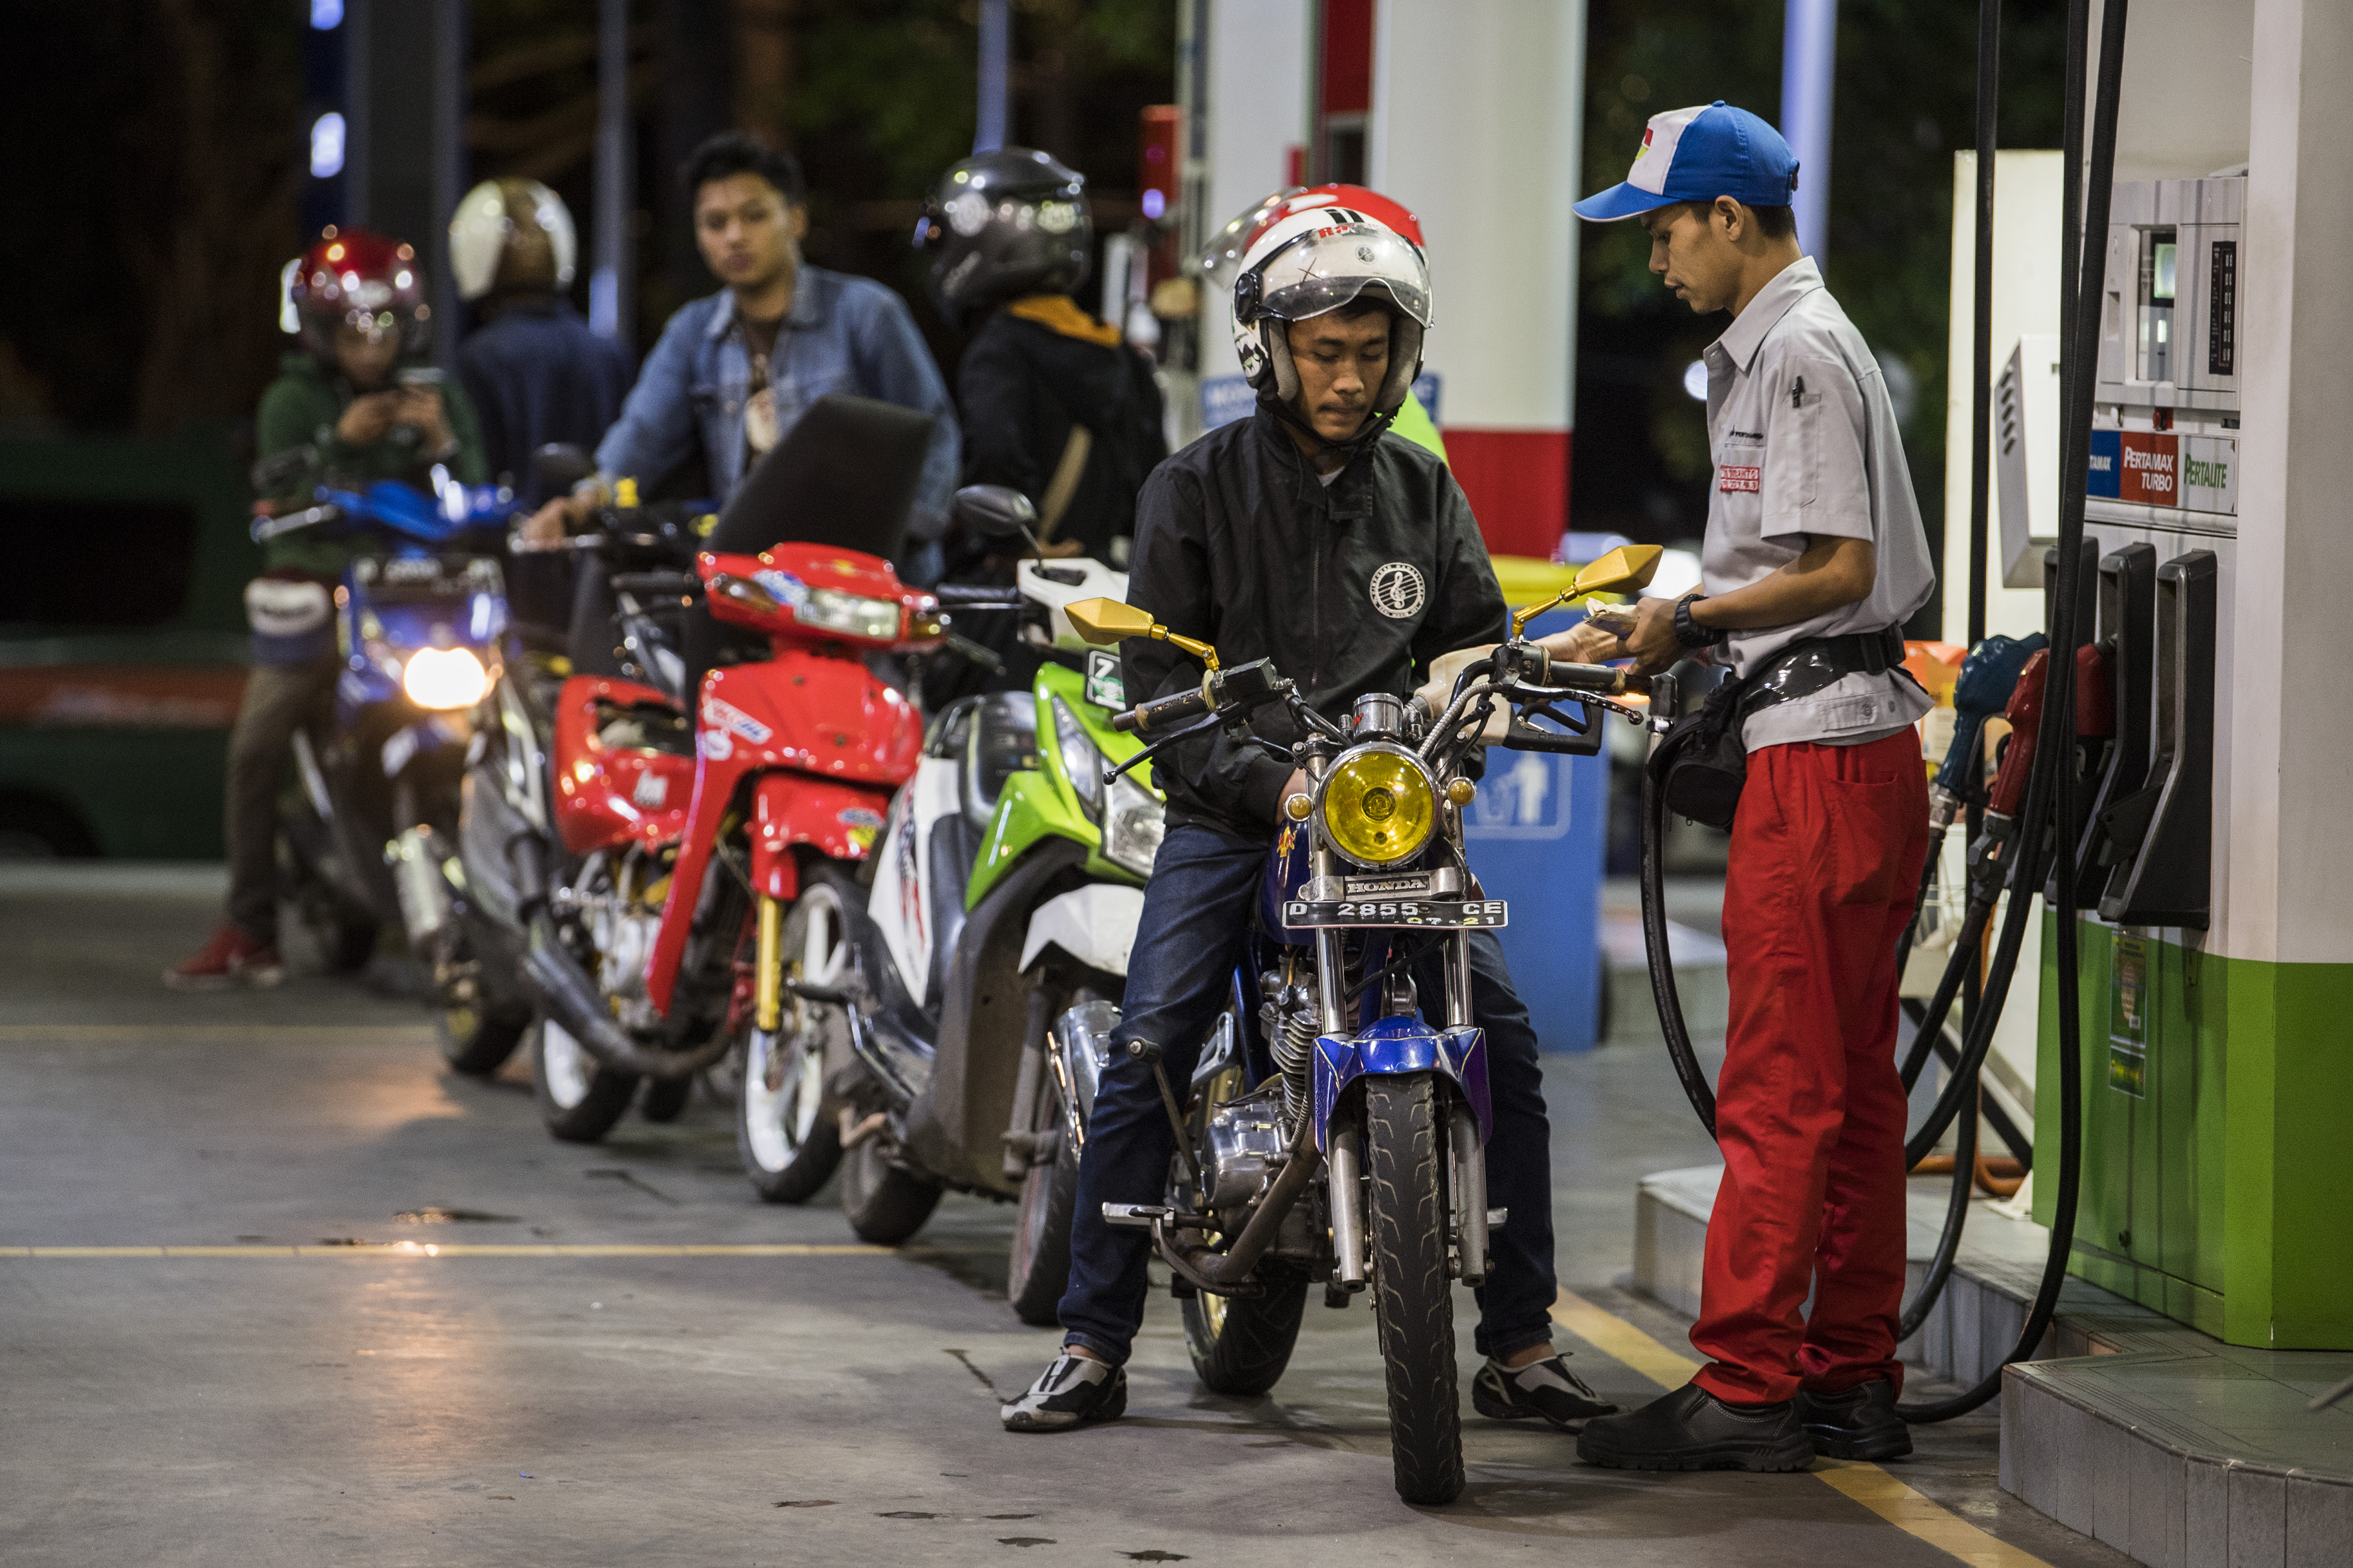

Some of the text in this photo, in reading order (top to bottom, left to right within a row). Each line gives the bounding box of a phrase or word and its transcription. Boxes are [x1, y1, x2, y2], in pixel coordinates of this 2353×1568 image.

[2124, 446, 2174, 472] PERTAMAX
[2184, 453, 2227, 489] PERTALITE
[2142, 472, 2172, 492] TURBO
[1347, 879, 1427, 893] HONDA
[1289, 902, 1502, 916] D 2855 CE
